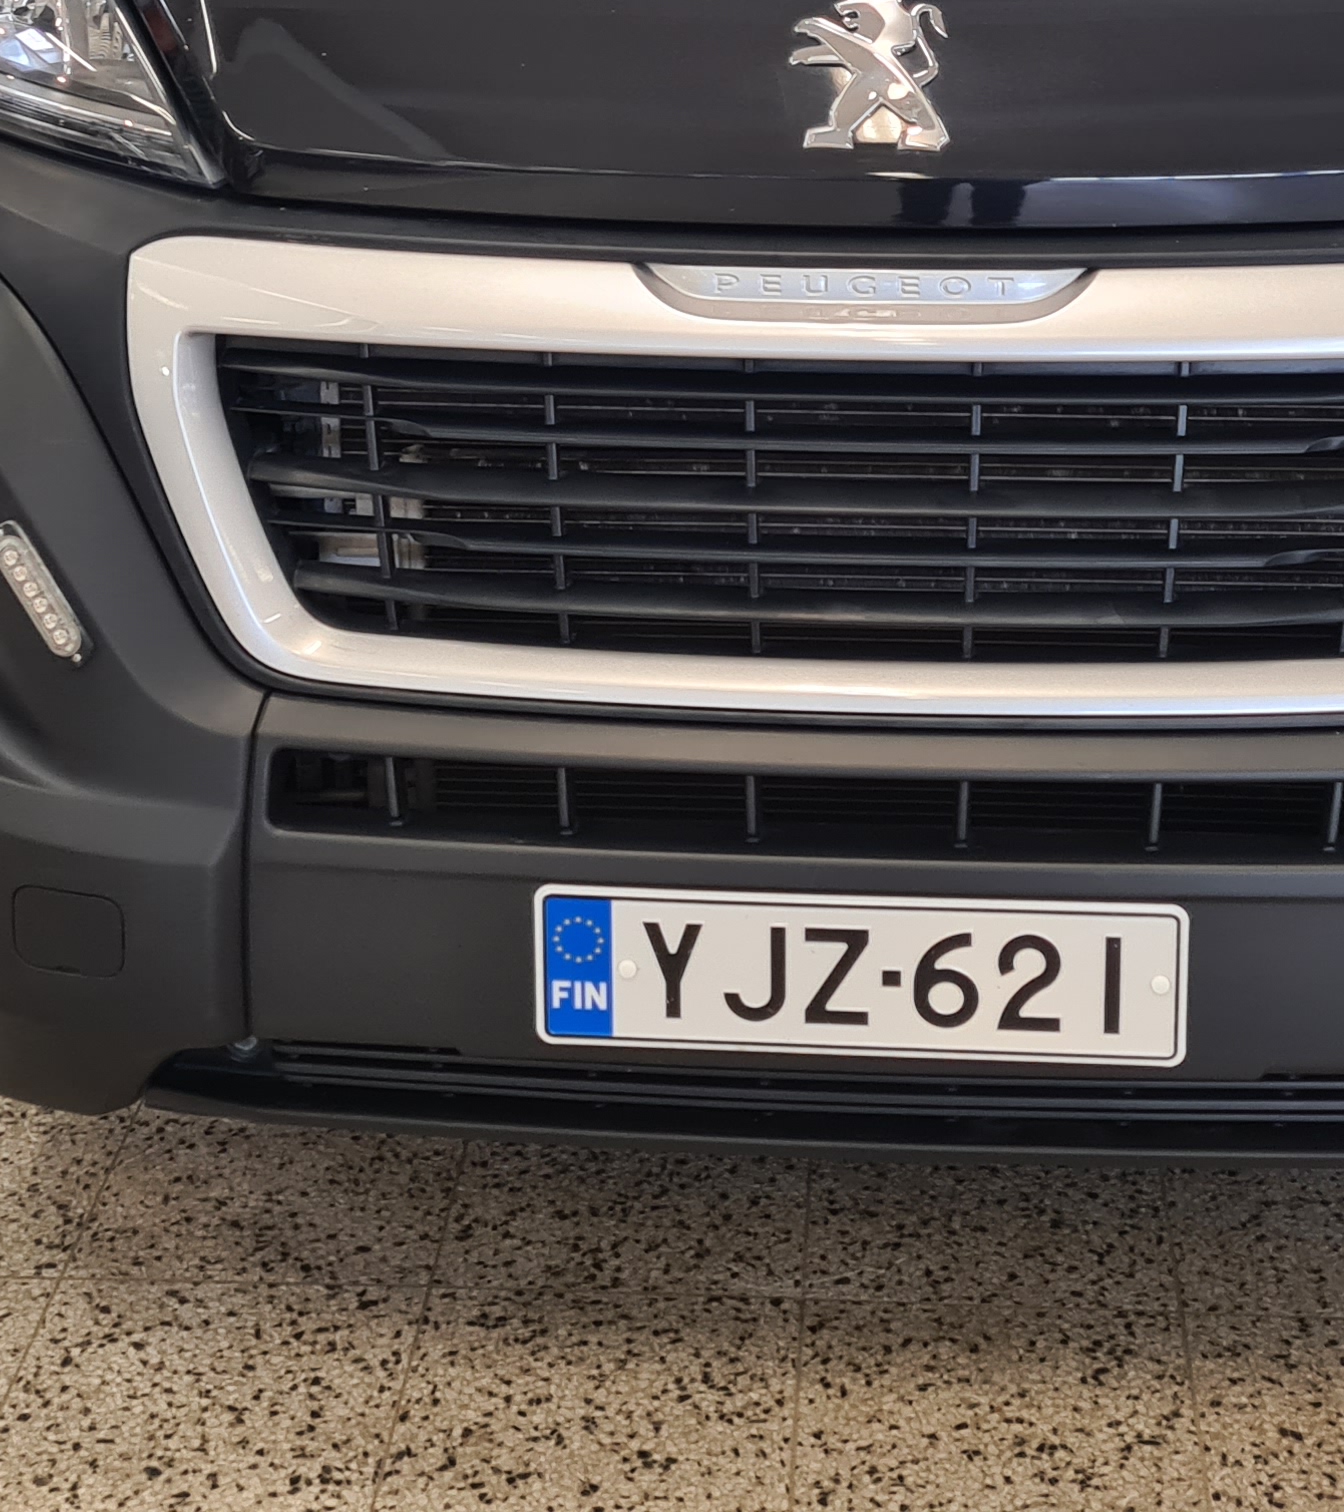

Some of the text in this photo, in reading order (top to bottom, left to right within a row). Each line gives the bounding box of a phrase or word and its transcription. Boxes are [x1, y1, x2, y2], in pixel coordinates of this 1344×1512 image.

[713, 272, 1015, 298] PEUGEOT
[551, 920, 1121, 1035] FIN YJZ-621
